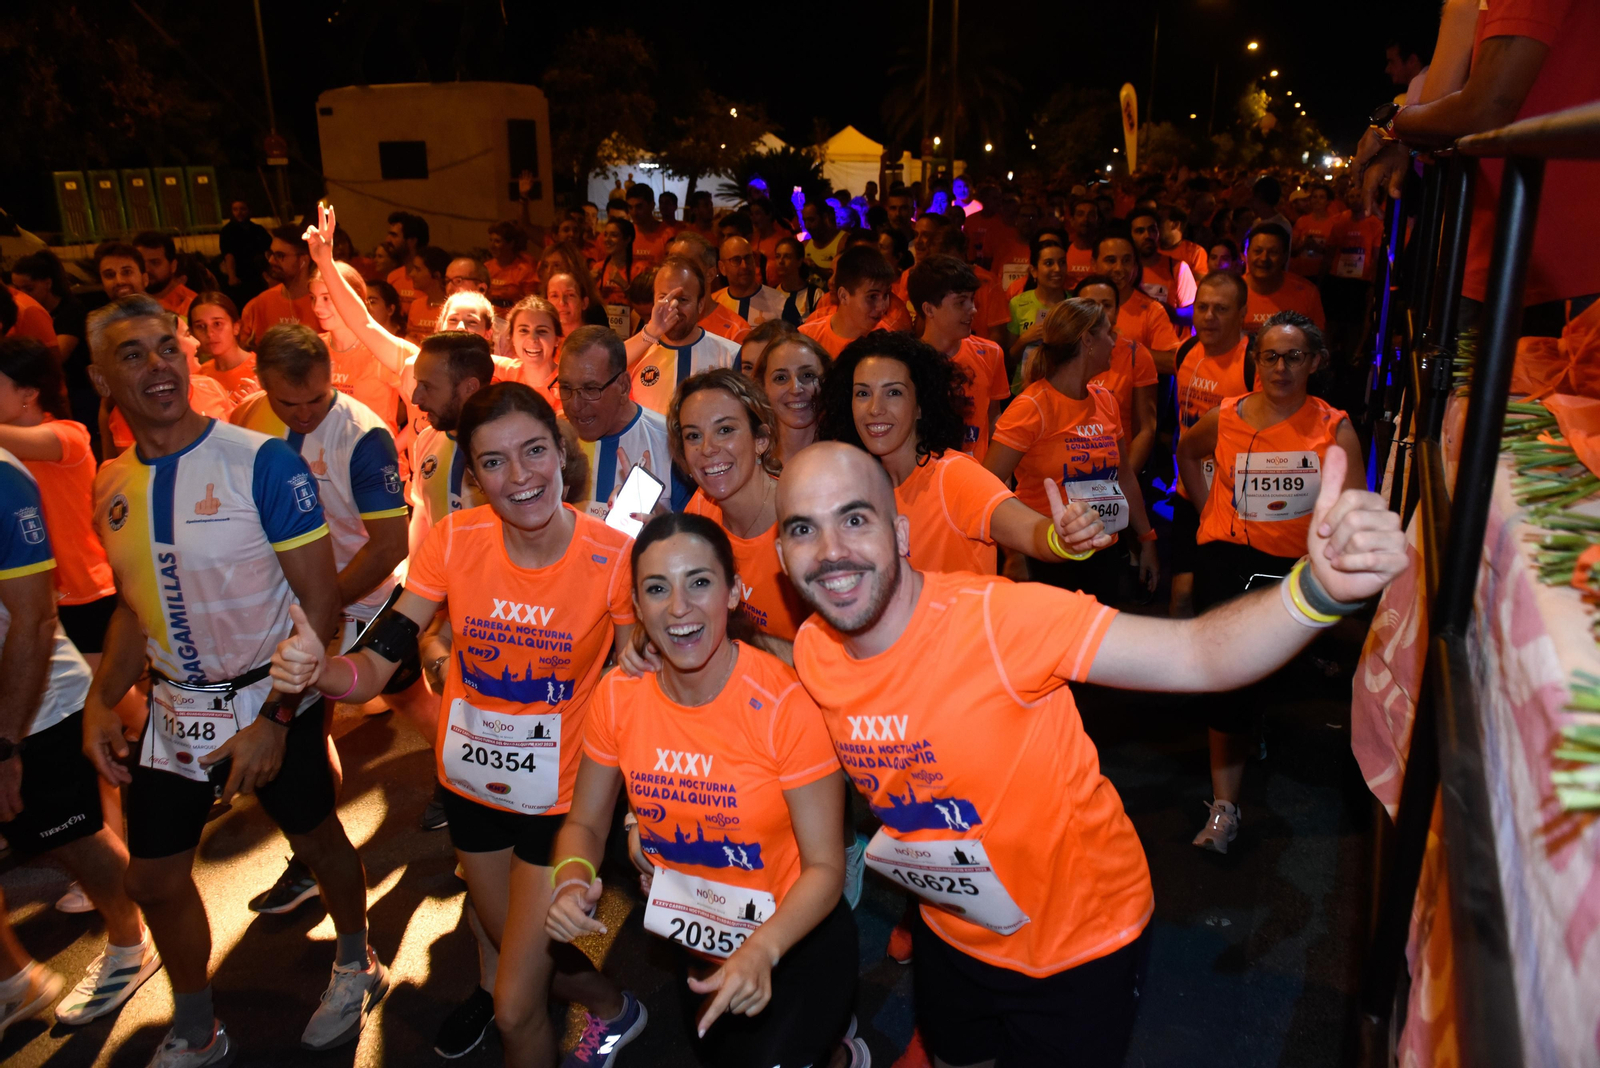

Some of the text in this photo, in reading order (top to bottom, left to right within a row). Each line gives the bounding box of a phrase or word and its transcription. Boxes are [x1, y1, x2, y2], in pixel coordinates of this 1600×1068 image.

[1192, 377, 1218, 392] XXXV
[1076, 424, 1104, 436] XXXV
[1251, 477, 1304, 491] 15189
[490, 598, 555, 627] XXXV
[465, 616, 573, 641] CARRERA NOCTURNA
[470, 628, 572, 652] GUADALQUIVIR
[164, 714, 215, 741] 11348
[847, 715, 908, 741] XXXV
[462, 743, 536, 772] 20354
[653, 748, 713, 778] XXXV
[630, 771, 736, 793] CARRERA NOCTURNA
[635, 784, 738, 808] GUADALQUIVIR
[892, 868, 980, 896] 16625
[656, 900, 668, 908] XXXV
[668, 918, 747, 953] 20353
